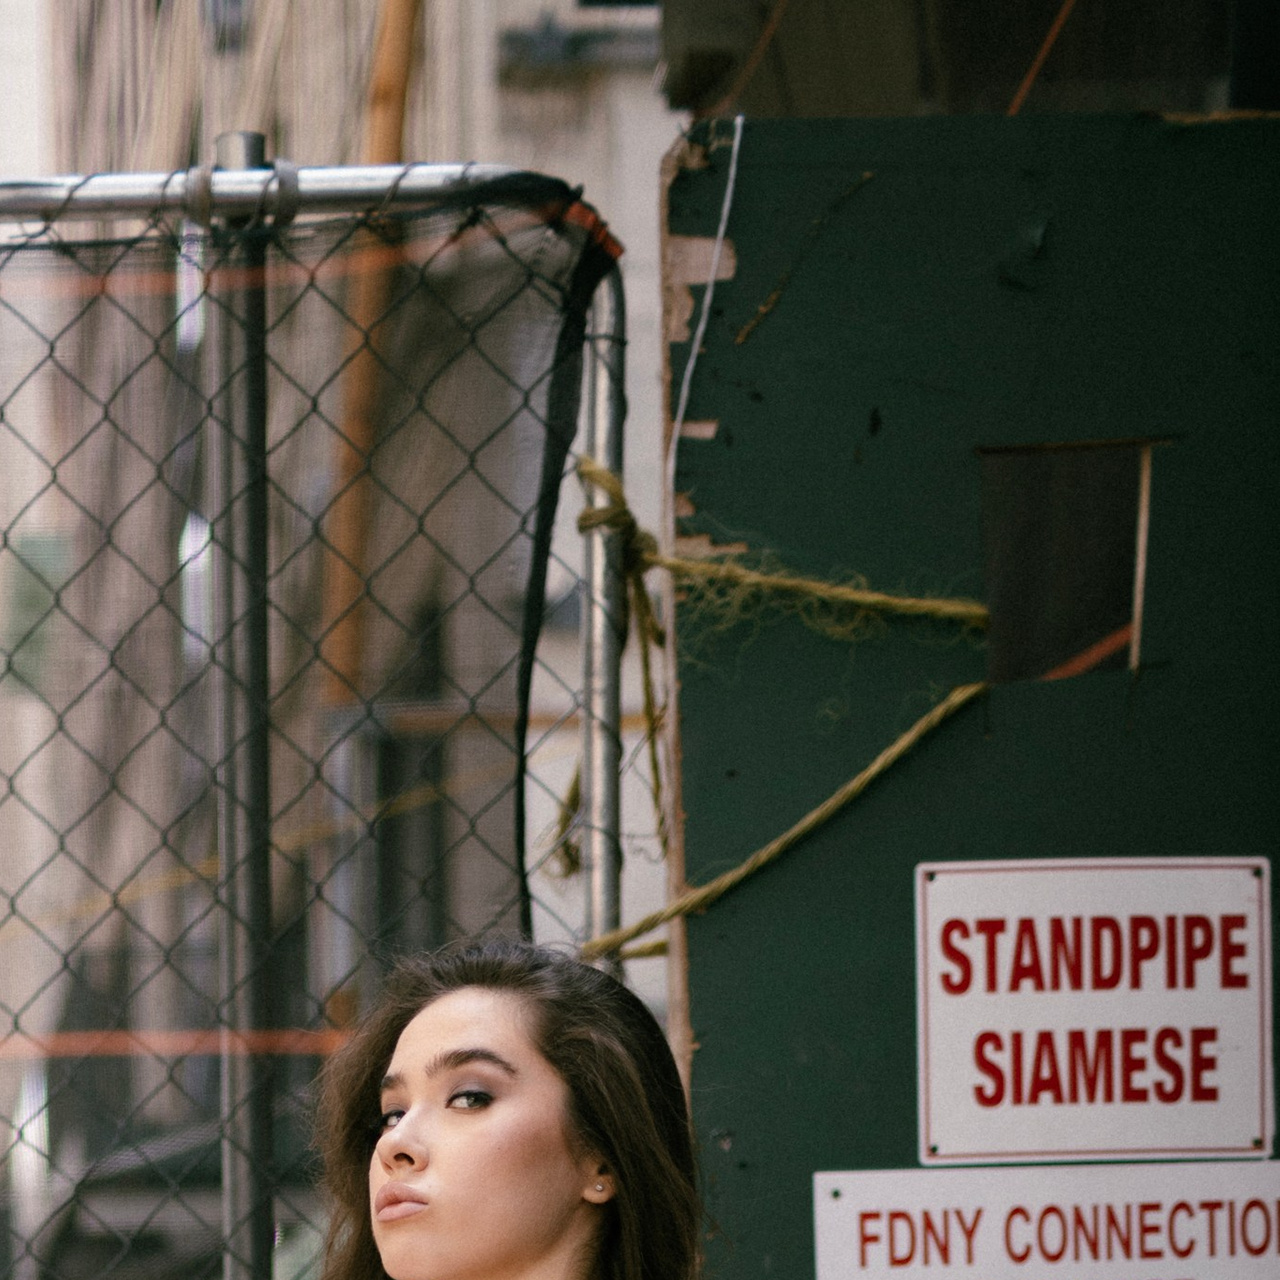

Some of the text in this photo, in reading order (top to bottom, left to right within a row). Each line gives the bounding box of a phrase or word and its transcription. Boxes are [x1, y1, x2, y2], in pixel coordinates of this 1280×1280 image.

[940, 914, 1249, 994] STANDPIPE
[973, 1027, 1219, 1107] SIAMESE
[858, 1198, 1280, 1268] FDNY CONNECTIO
